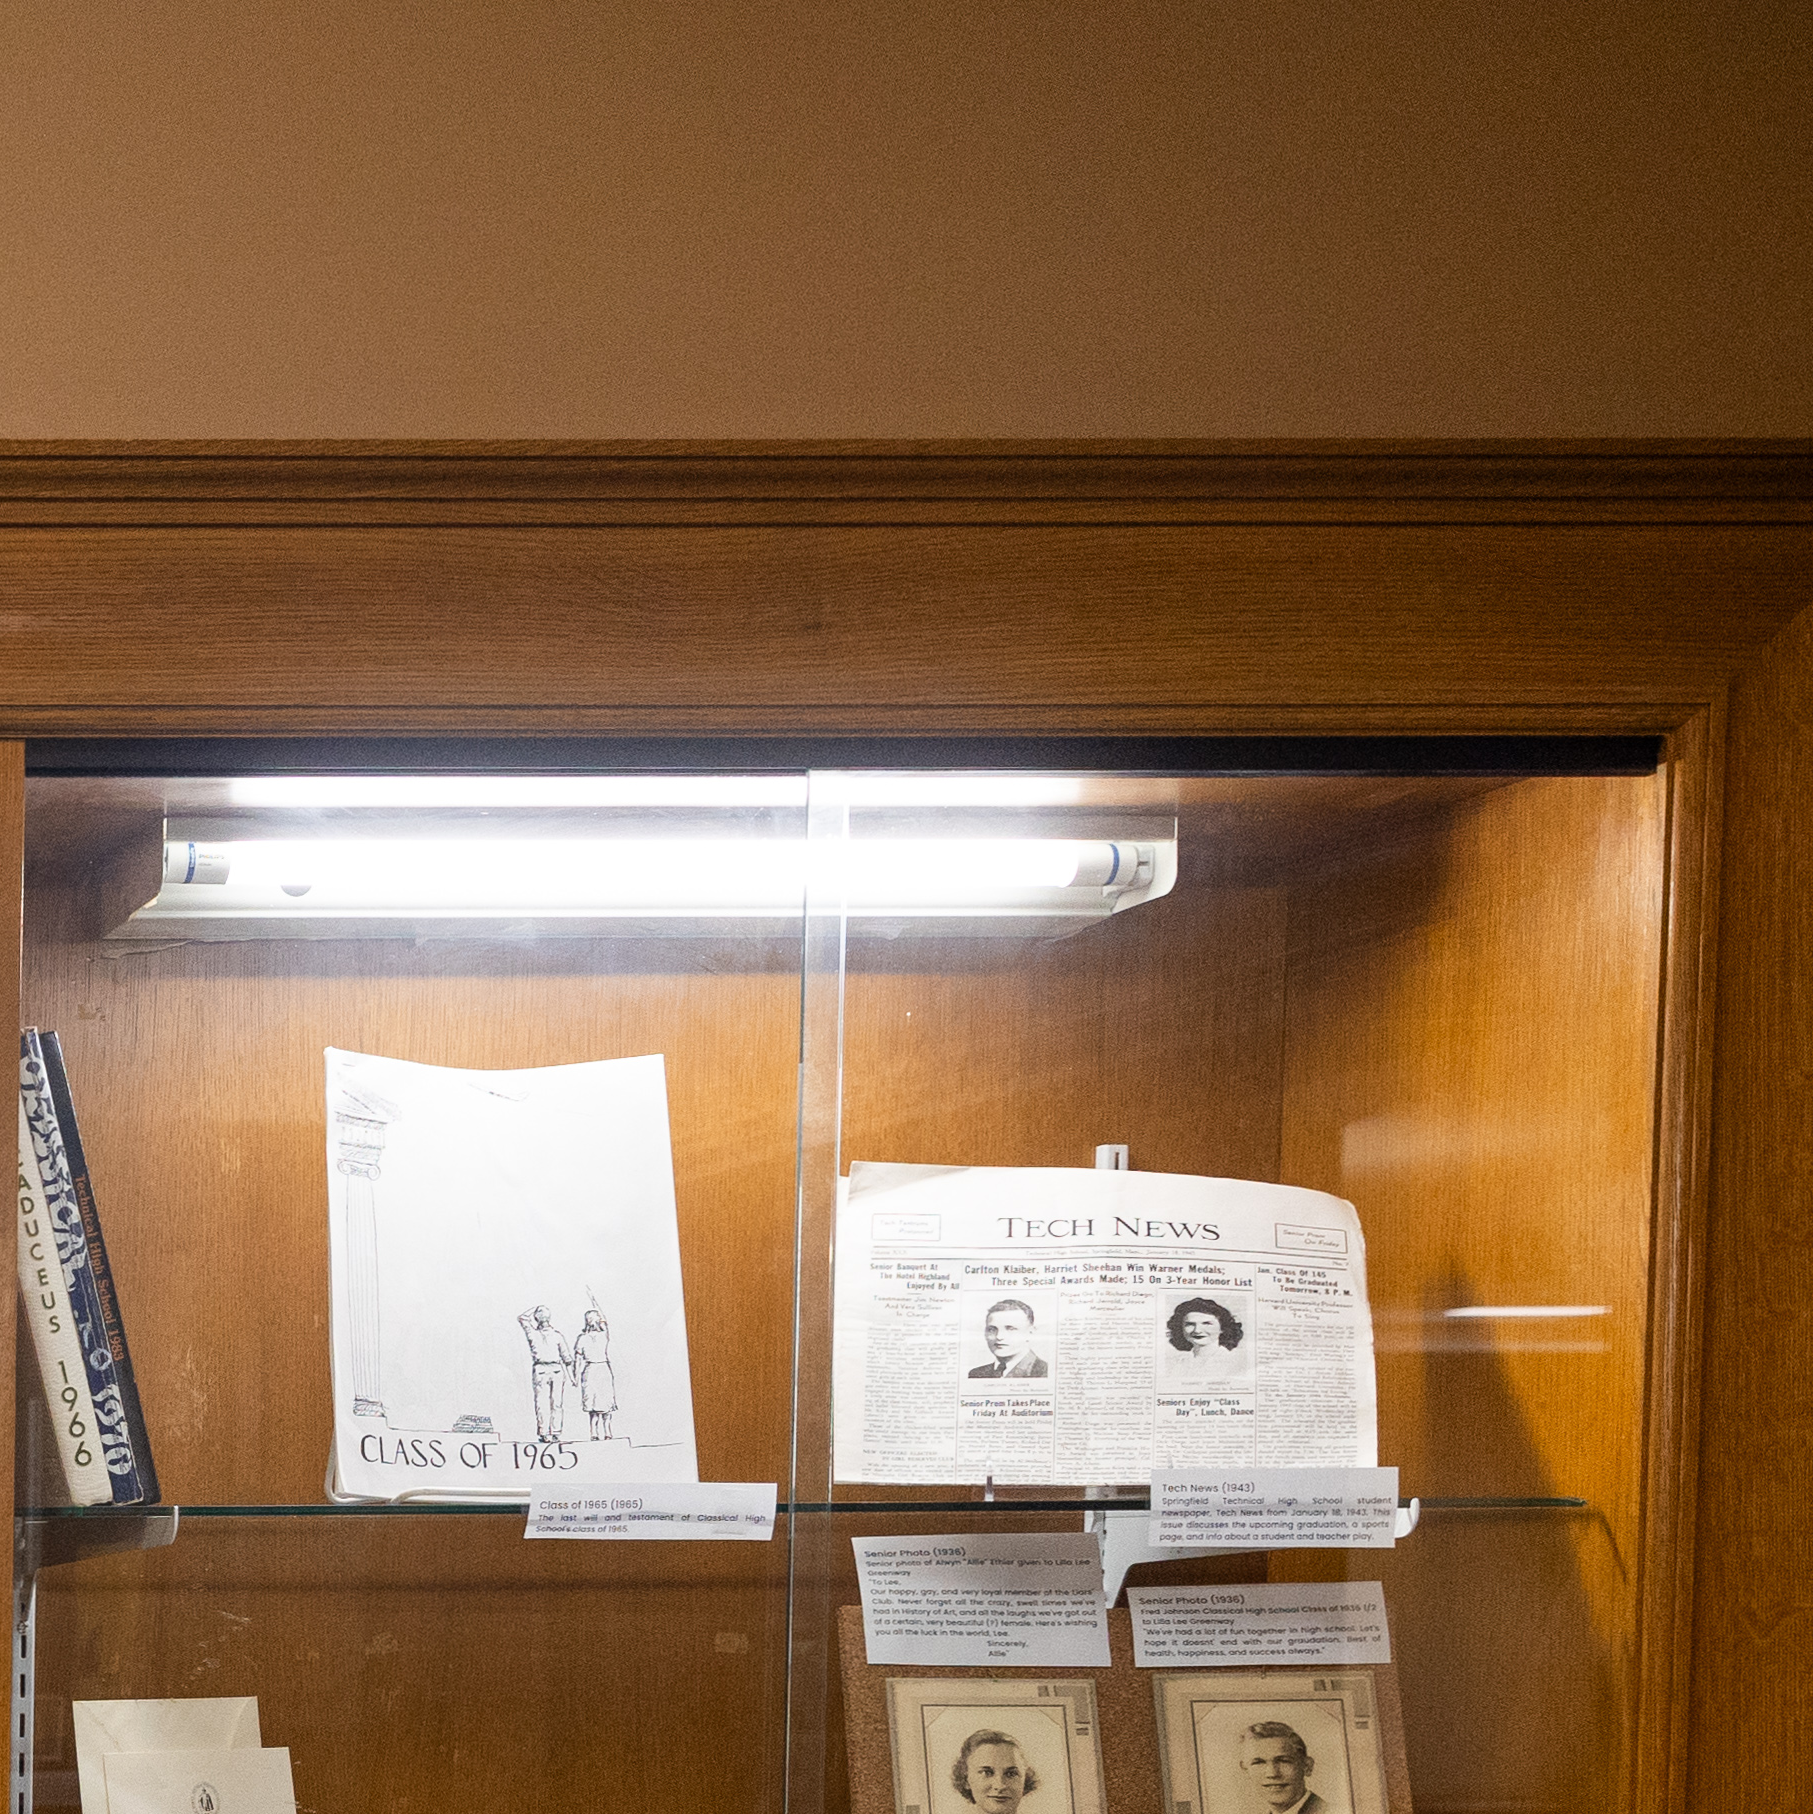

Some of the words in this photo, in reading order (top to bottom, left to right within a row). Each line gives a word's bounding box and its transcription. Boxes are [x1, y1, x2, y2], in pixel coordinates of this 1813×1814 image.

[75, 1175, 99, 1241] Technical
[997, 1217, 1096, 1238] TECH
[1112, 1216, 1221, 1240] NEWS
[17, 1155, 61, 1334] ADUCEUS
[87, 1241, 107, 1278] High
[964, 1264, 1002, 1274] Carlton
[1044, 1263, 1078, 1274] Harriet
[1126, 1263, 1145, 1273] Win
[1149, 1263, 1184, 1274] Warner
[95, 1278, 118, 1324] School
[57, 1360, 93, 1467] 1966
[91, 1382, 133, 1476] 1970
[360, 1434, 448, 1468] CLASS
[460, 1442, 499, 1468] OF
[513, 1443, 578, 1470] 1965
[1162, 1483, 1188, 1493] Tech
[1190, 1483, 1219, 1492] News
[1221, 1480, 1255, 1494] (1943)
